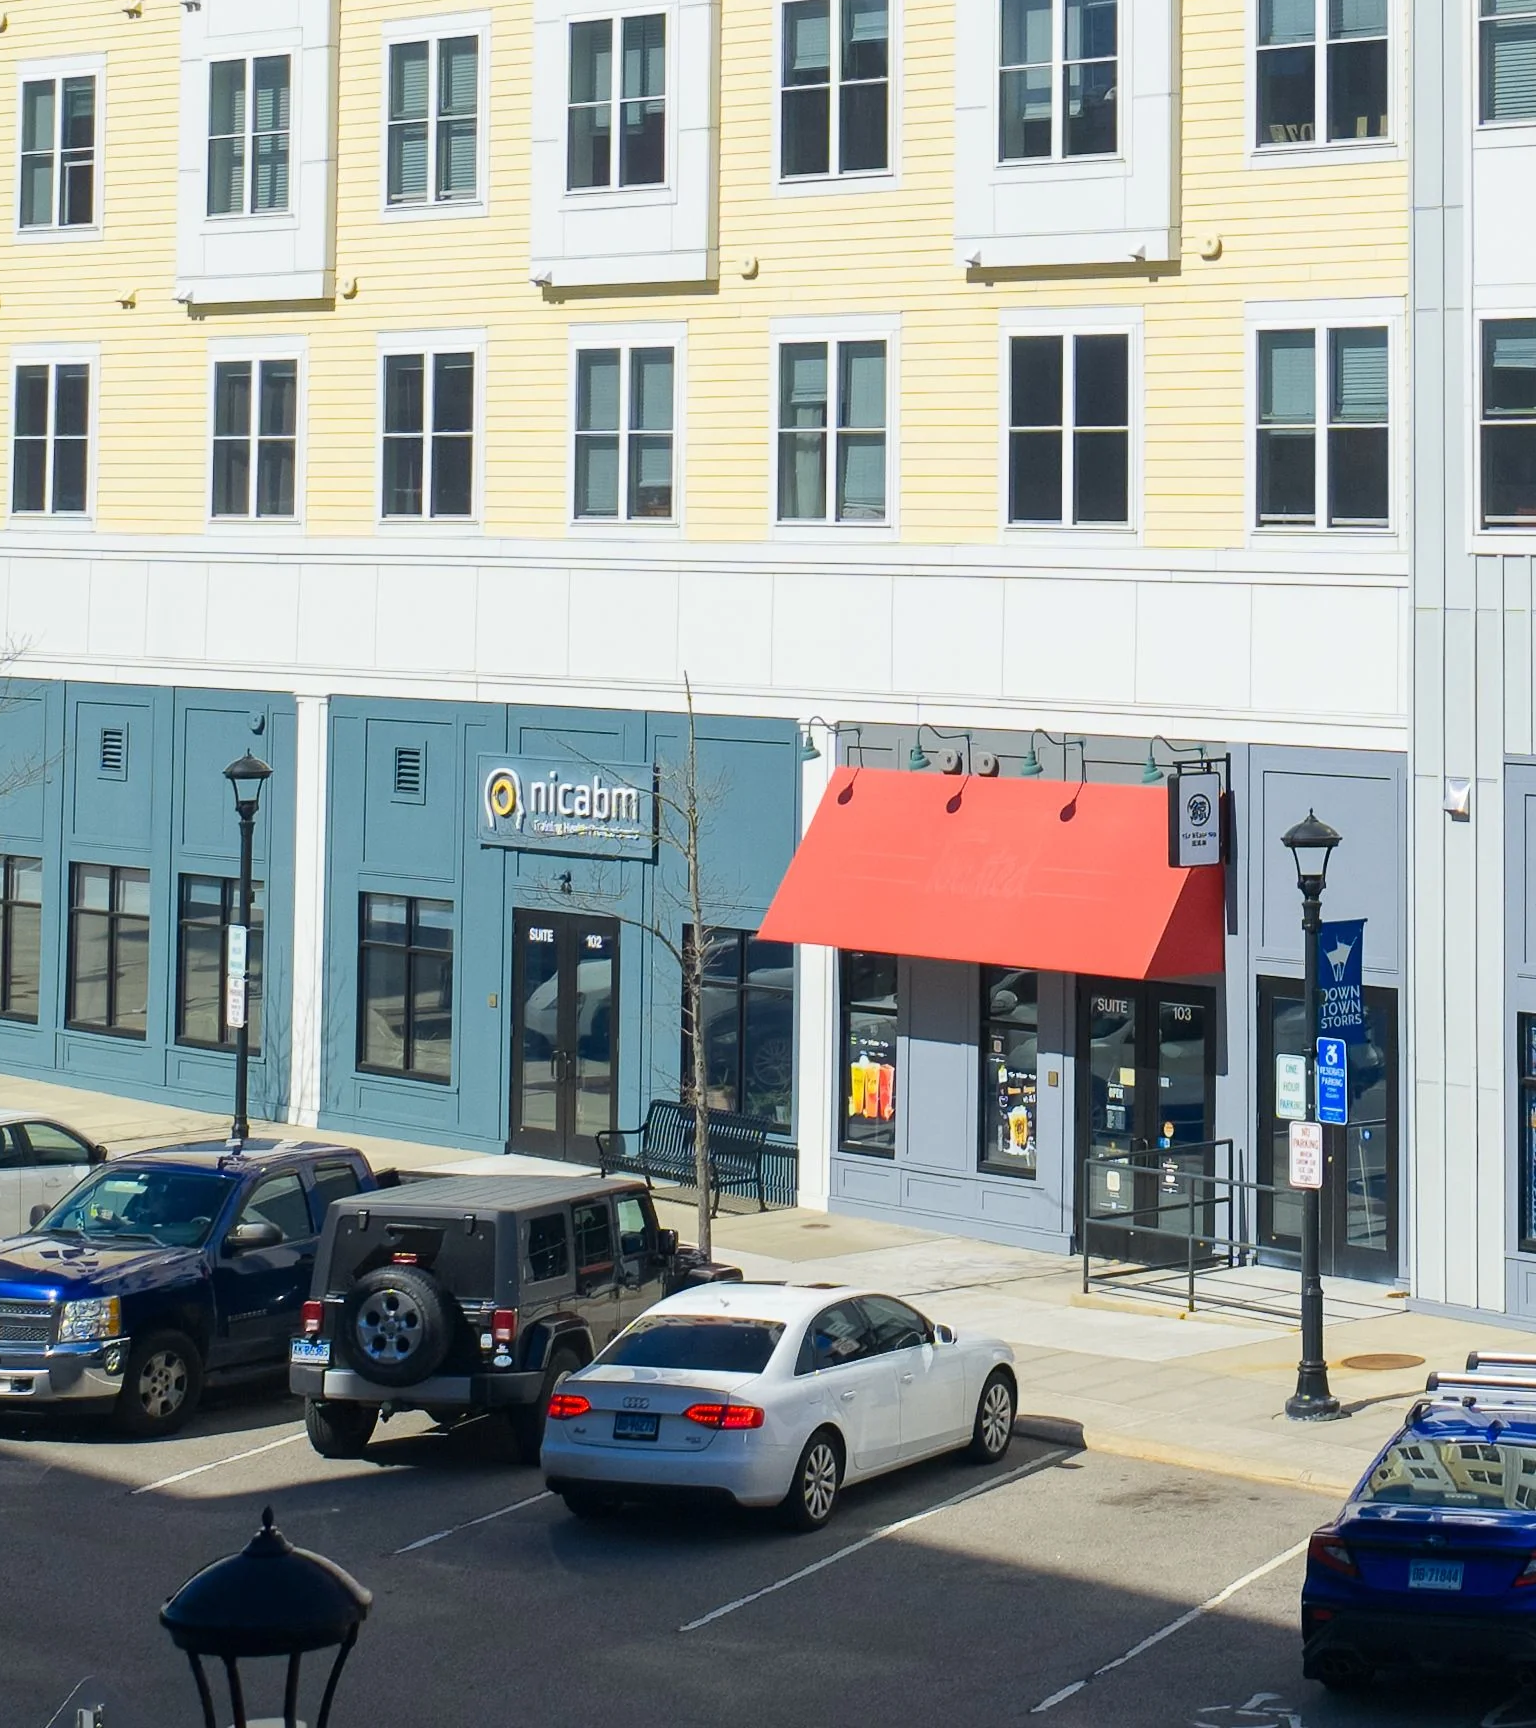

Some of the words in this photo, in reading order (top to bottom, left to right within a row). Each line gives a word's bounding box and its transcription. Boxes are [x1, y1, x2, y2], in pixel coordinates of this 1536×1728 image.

[530, 770, 640, 821] nicabm
[529, 927, 554, 943] SUITE
[585, 934, 603, 949] 102
[1097, 997, 1128, 1014] SUITE
[1172, 1006, 1192, 1021] 103
[1322, 1000, 1362, 1017] TOWN
[1321, 1013, 1363, 1029] STORRS
[1285, 1064, 1298, 1075] ONE
[1283, 1081, 1300, 1093] HOUR
[1321, 1076, 1344, 1088] PARKING
[1279, 1098, 1304, 1110] PARKING
[1301, 1127, 1311, 1137] NO
[1293, 1138, 1319, 1150] PARKING
